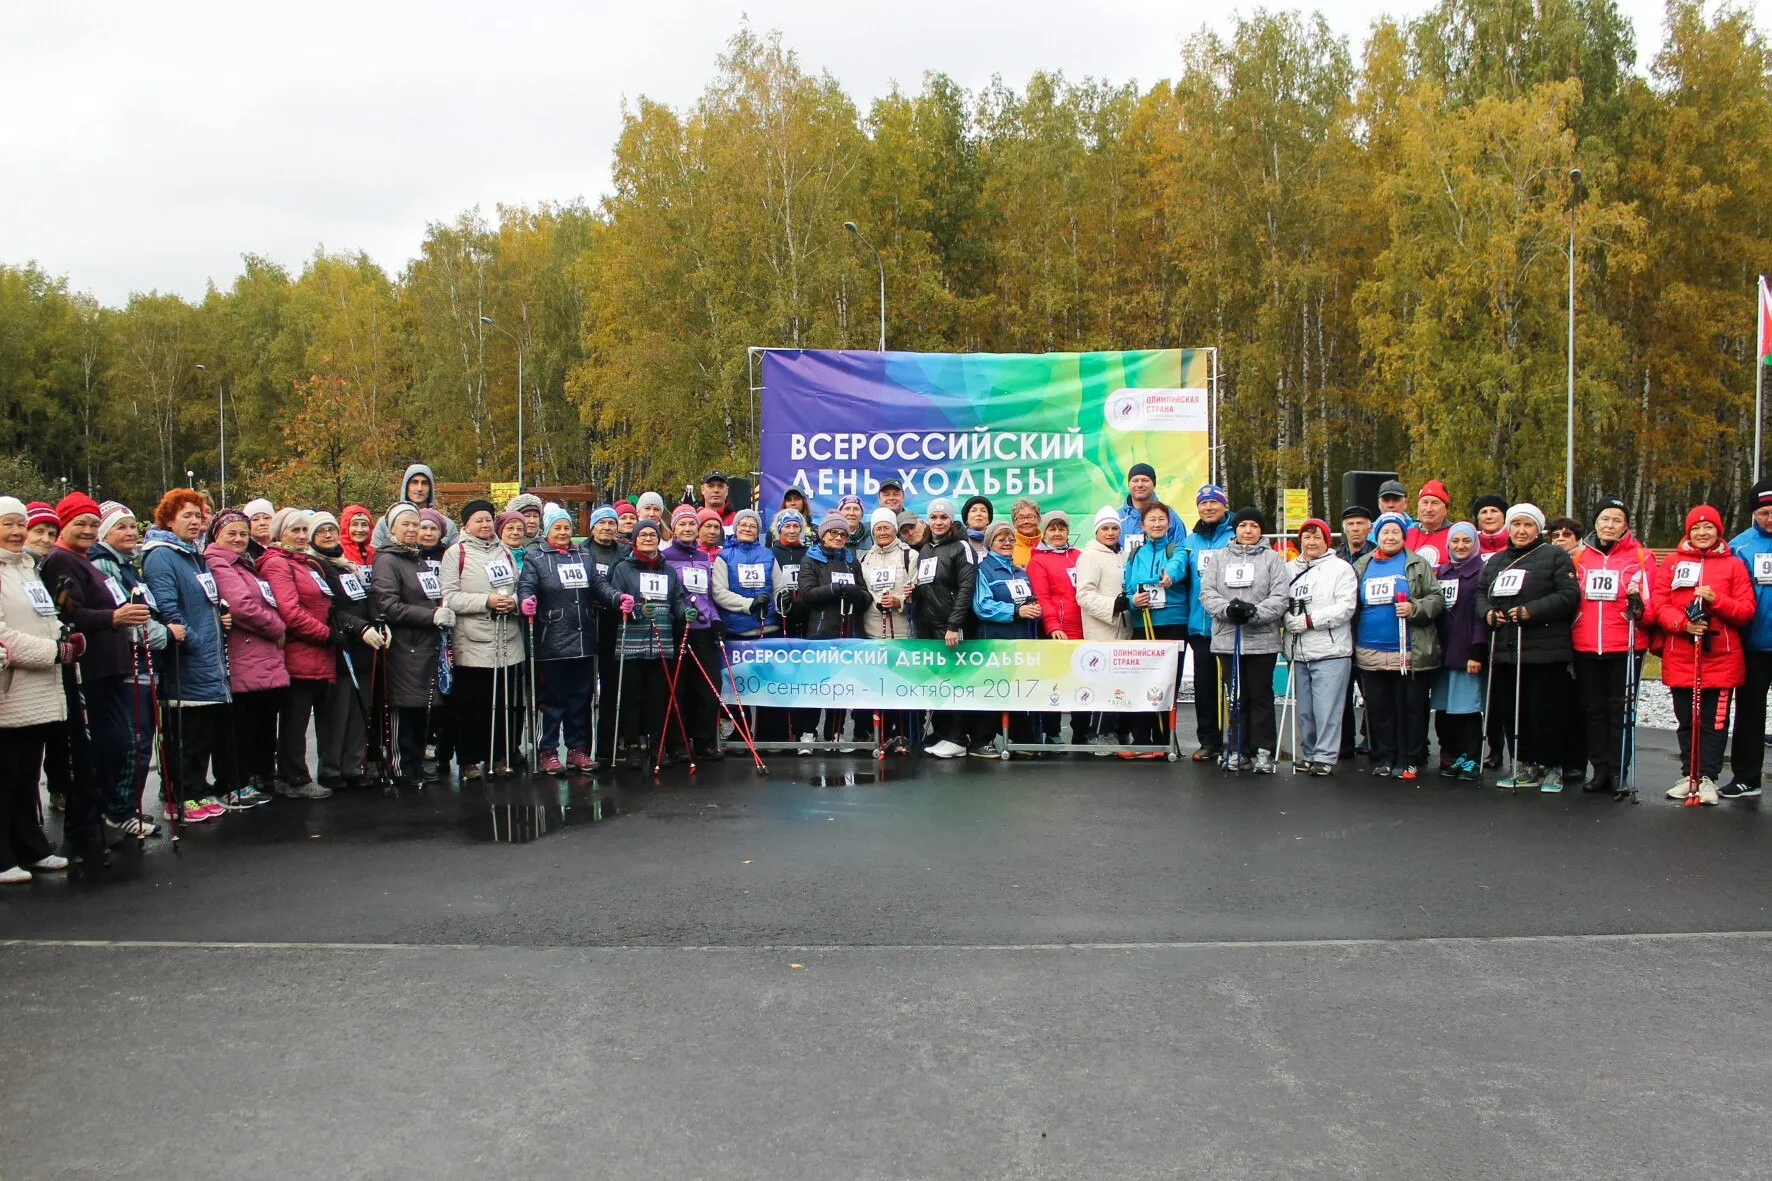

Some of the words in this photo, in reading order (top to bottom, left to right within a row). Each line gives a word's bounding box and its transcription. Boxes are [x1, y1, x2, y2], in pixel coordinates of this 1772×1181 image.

[1146, 394, 1200, 404] ОЛИМПИЙСКАЯ
[1146, 405, 1174, 413] СТРАНА
[791, 426, 1084, 461] ВСЕРОССИЙСКИЙ
[793, 468, 881, 499] ДЕНЬ
[897, 468, 1054, 499] ХОДЬБЫ
[490, 564, 509, 577] 131
[562, 569, 584, 581] 148
[745, 570, 760, 581] 25
[876, 570, 890, 583] 29
[1235, 569, 1244, 580] 9
[1677, 567, 1691, 580] 18
[344, 578, 361, 592] 187
[422, 578, 438, 591] 183
[649, 579, 661, 592] 11
[693, 573, 699, 586] 1
[1500, 574, 1518, 588] 177
[1591, 575, 1613, 590] 178
[27, 587, 50, 604] 102
[1015, 584, 1026, 595] 47
[1294, 584, 1309, 597] 176
[1370, 583, 1390, 596] 175
[1441, 586, 1456, 600] 191
[732, 646, 888, 665] ВСЕРОССИЙСКИЙ
[895, 651, 947, 667] ДЕНЬ
[955, 651, 1041, 667] ХОДЬБЫ
[1113, 648, 1165, 658] ОЛИМПИЙСКАЯ
[1113, 658, 1140, 666] СТРАНА
[734, 675, 761, 695] 30
[766, 676, 854, 702] сентября
[878, 677, 885, 696] 1
[895, 677, 975, 703] октября
[983, 678, 1040, 699] 2017
[1108, 699, 1132, 707] TAFISA
